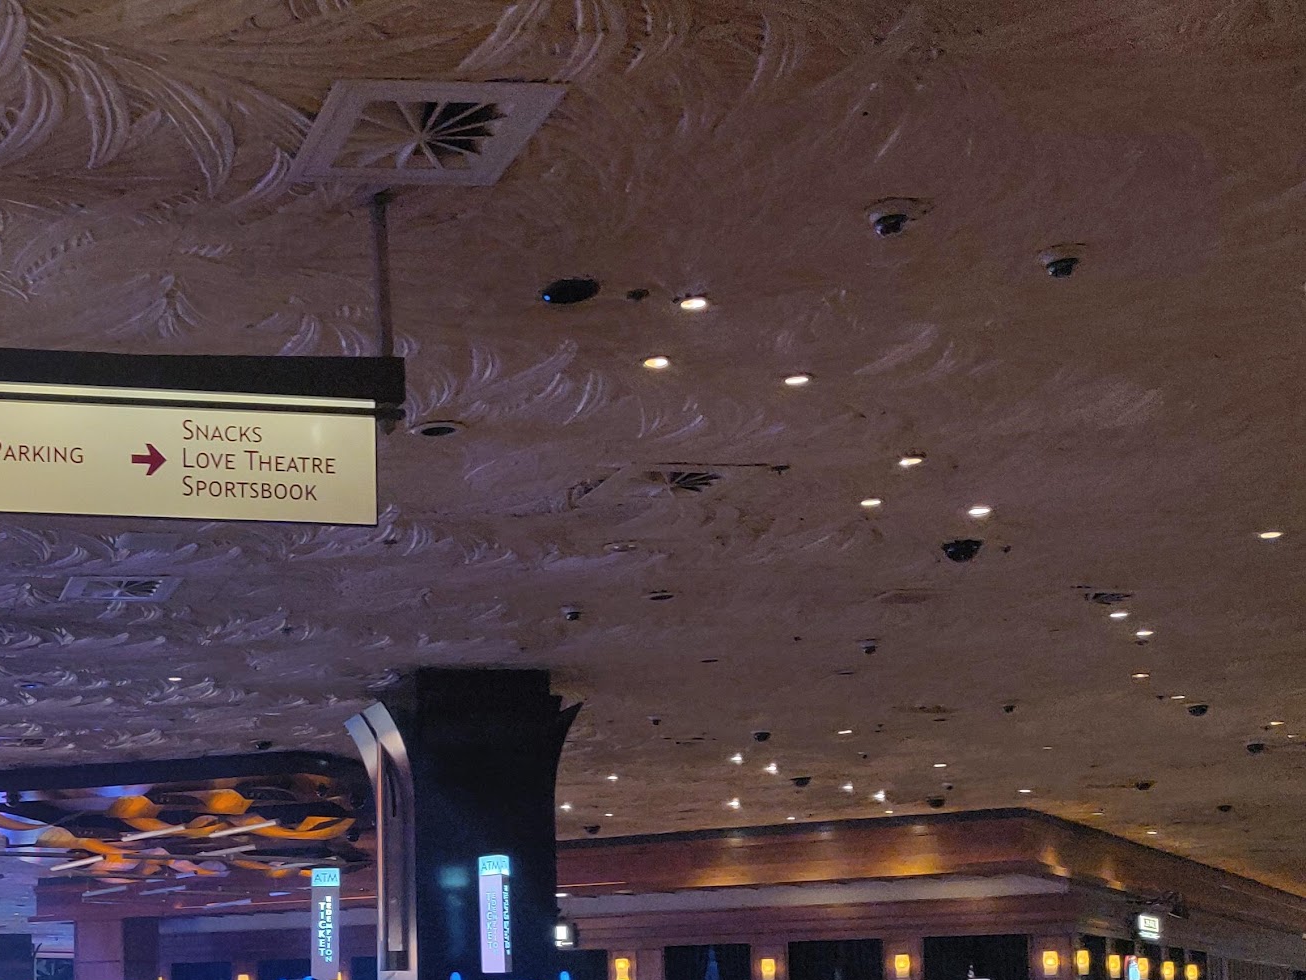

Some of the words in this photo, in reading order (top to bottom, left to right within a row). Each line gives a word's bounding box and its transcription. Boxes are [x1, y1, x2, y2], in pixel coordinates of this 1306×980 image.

[182, 419, 263, 443] SNACKS
[182, 447, 235, 471] LOVE
[244, 450, 336, 475] THEATRE
[182, 475, 318, 501] SPORTSBOOK
[314, 872, 338, 882] ATM
[481, 861, 500, 872] ATM
[318, 902, 326, 957] TICKET
[486, 892, 494, 949] TICKET
